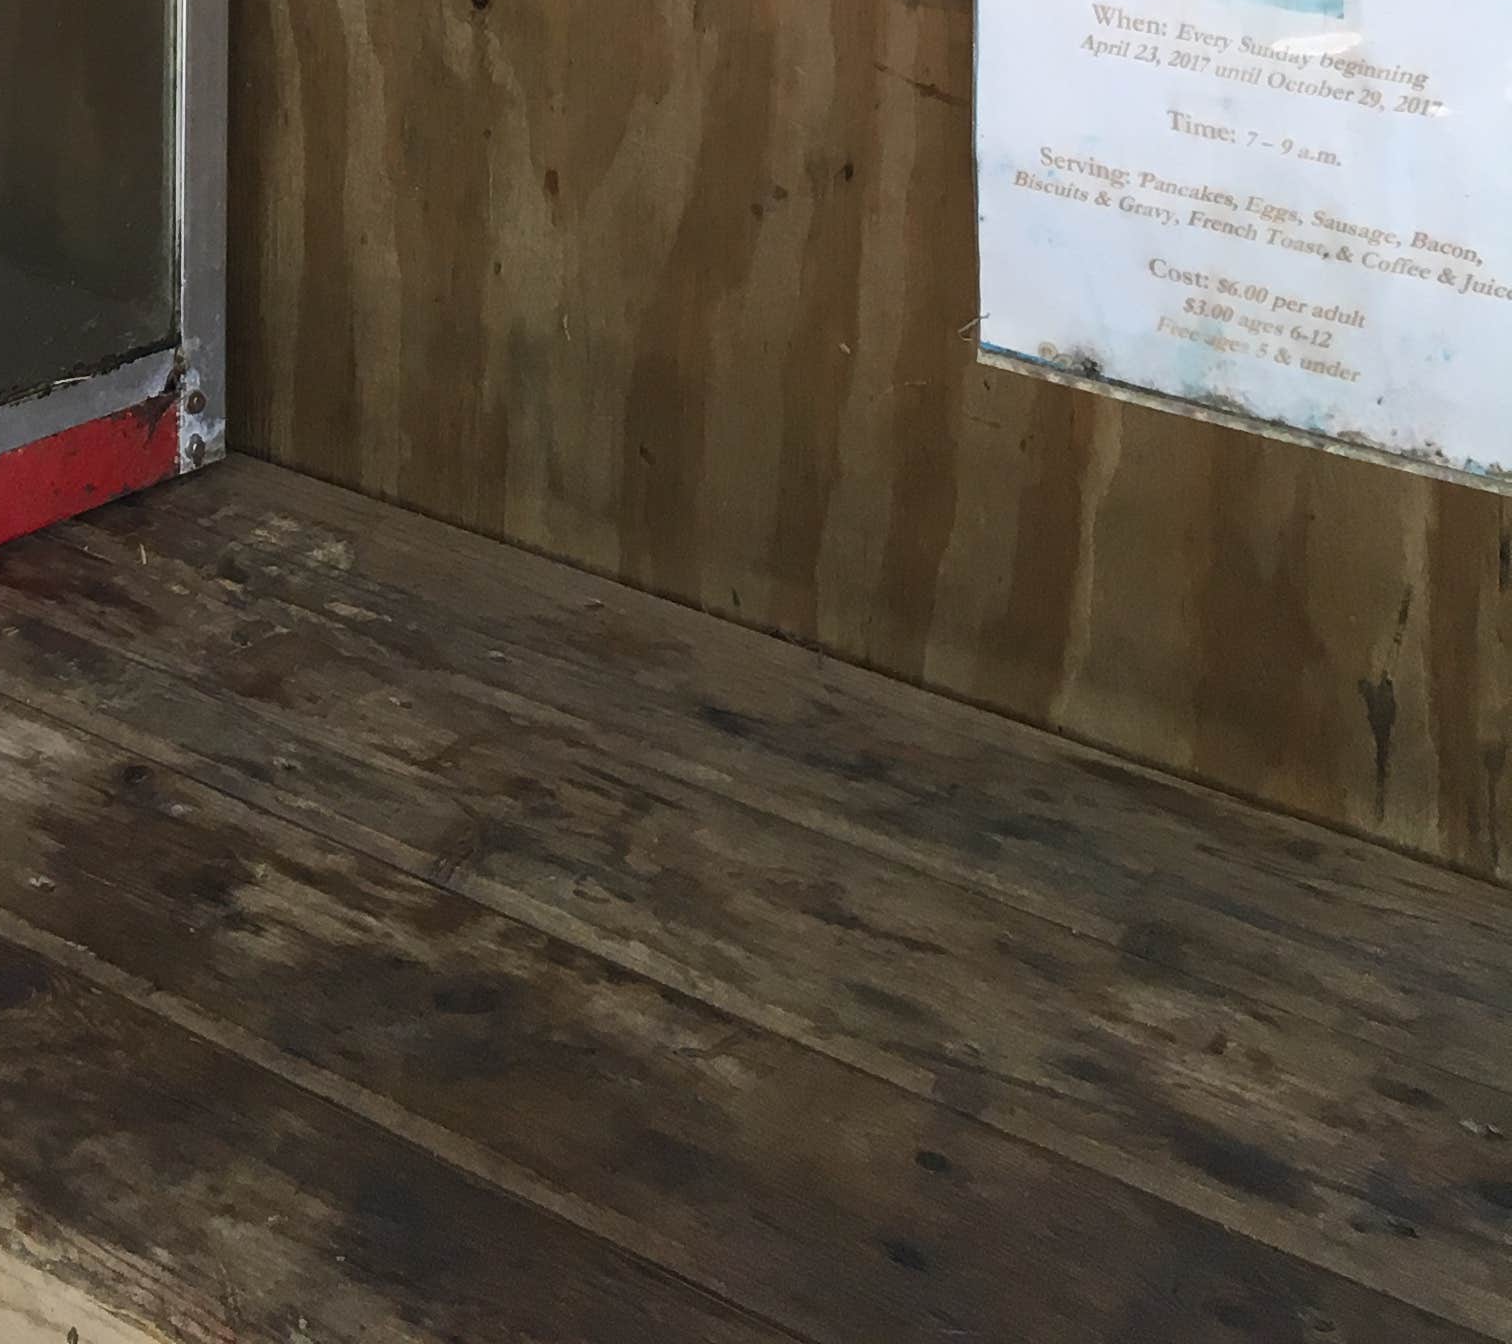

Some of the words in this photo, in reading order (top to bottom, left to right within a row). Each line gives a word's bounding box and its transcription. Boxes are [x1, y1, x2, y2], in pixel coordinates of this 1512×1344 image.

[1080, 34, 1130, 57] April
[1134, 43, 1161, 67] 23,
[1167, 50, 1211, 73] 2017
[1215, 63, 1263, 86] until
[1267, 71, 1355, 102] October
[1358, 88, 1386, 112] 29,
[1092, 3, 1168, 37] When:
[1176, 22, 1233, 54] Every
[1238, 35, 1314, 70] Sunday
[1320, 52, 1430, 91] beginning
[1166, 110, 1236, 144] Time:
[1246, 131, 1259, 147] 7
[1281, 138, 1294, 155] 9
[1297, 147, 1342, 167] a.m.
[1013, 170, 1089, 203] Biscuits
[1094, 190, 1113, 208] &
[1118, 194, 1180, 227] Gravy,
[1187, 210, 1259, 242] French
[1267, 227, 1330, 261] Toast,
[1335, 246, 1354, 263] &
[1361, 251, 1432, 281] Coffee
[1437, 267, 1458, 287] &
[1039, 146, 1132, 189] Serving:
[1138, 170, 1239, 211] Pancakes,
[1245, 194, 1305, 226] Eggs,
[1311, 209, 1403, 249] Sausage,
[1410, 230, 1483, 268] Bacon,
[1148, 257, 1210, 290] Cost:
[1216, 277, 1269, 304] $6.00
[1272, 295, 1308, 314] per
[1311, 305, 1367, 329] adult
[1182, 296, 1235, 323] $3.00
[1238, 315, 1285, 337] ages
[1290, 325, 1333, 349] 6-12
[1156, 315, 1201, 342] Free
[1255, 343, 1269, 359] 5
[1273, 347, 1291, 366] &
[1299, 356, 1362, 383] under
